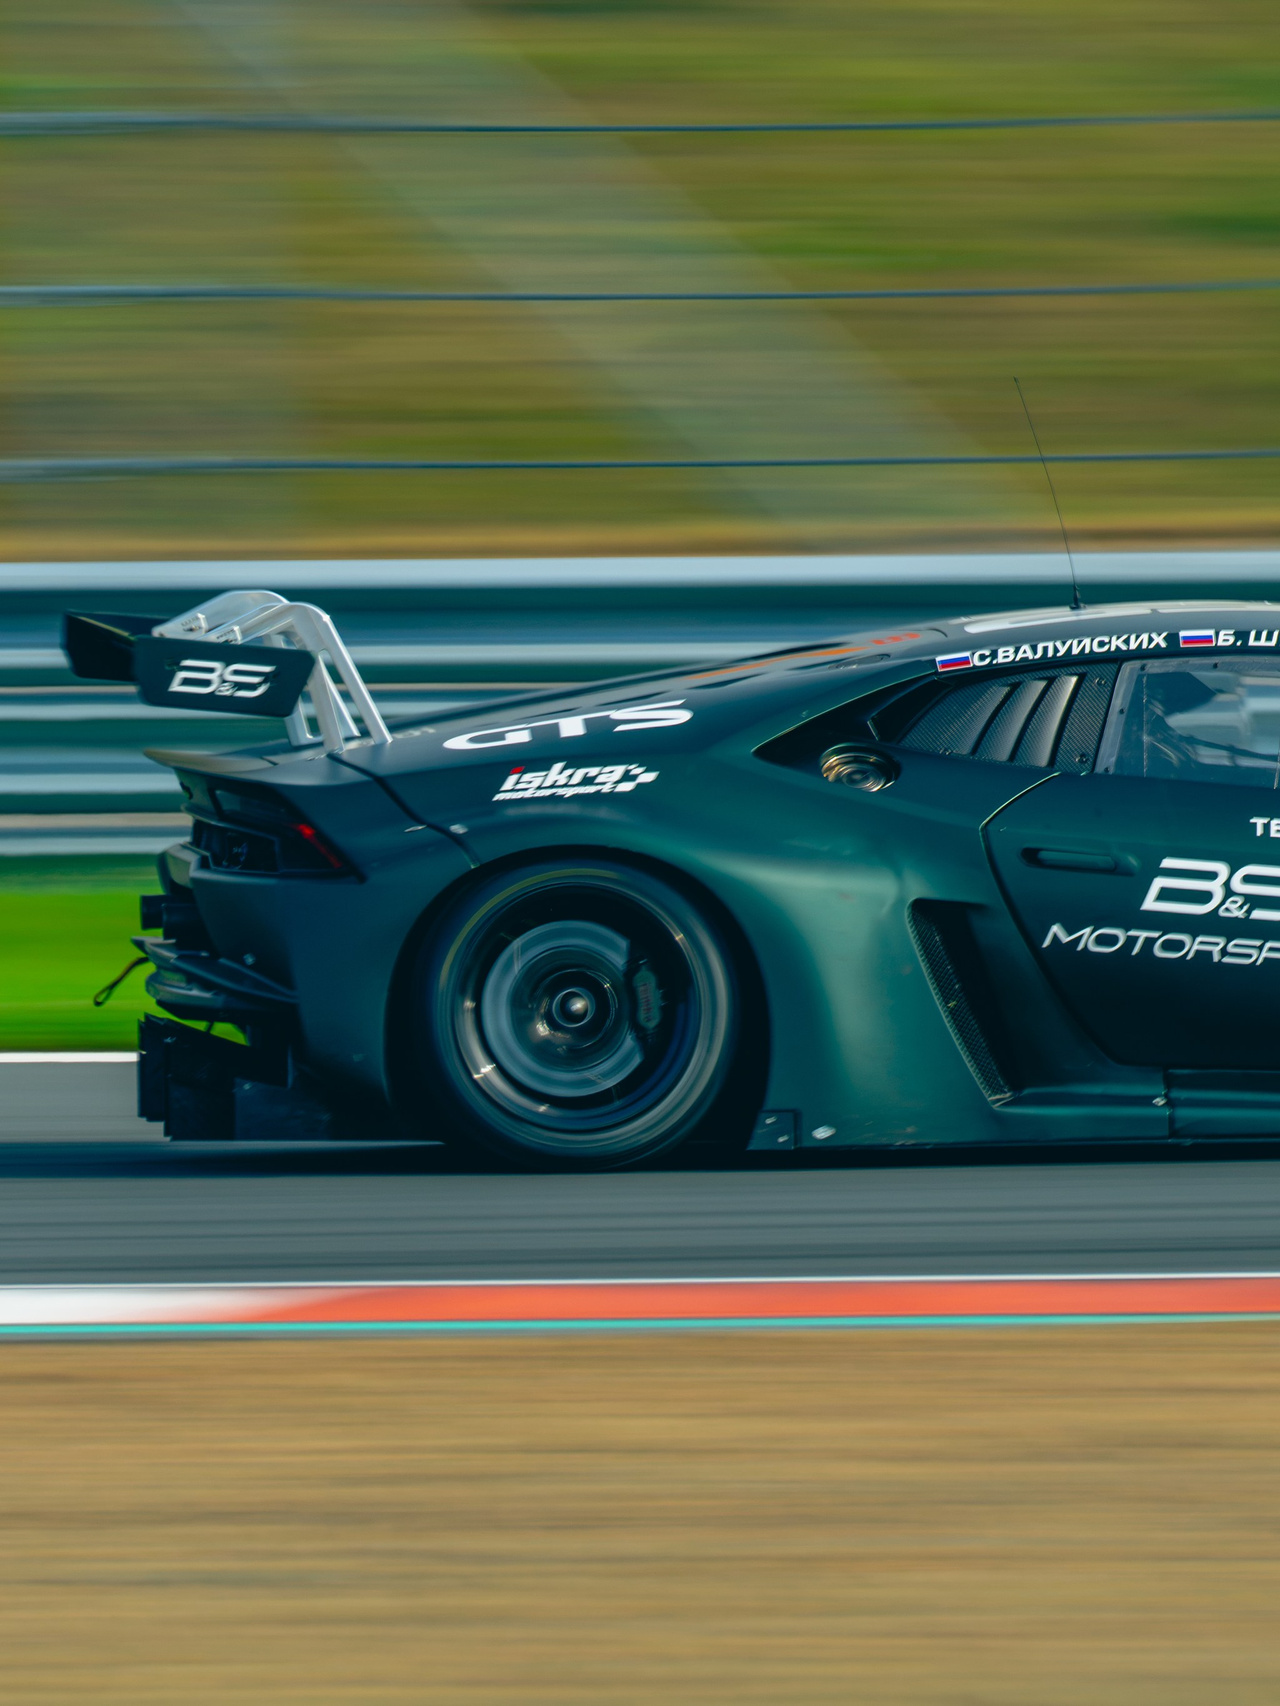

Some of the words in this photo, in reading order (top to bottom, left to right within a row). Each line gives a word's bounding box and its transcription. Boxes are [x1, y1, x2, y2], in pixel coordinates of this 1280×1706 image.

[1217, 628, 1242, 646] Б.
[168, 659, 277, 698] B&S
[442, 699, 694, 750] GTS
[491, 780, 617, 801] motorsport
[500, 761, 630, 791] iskra
